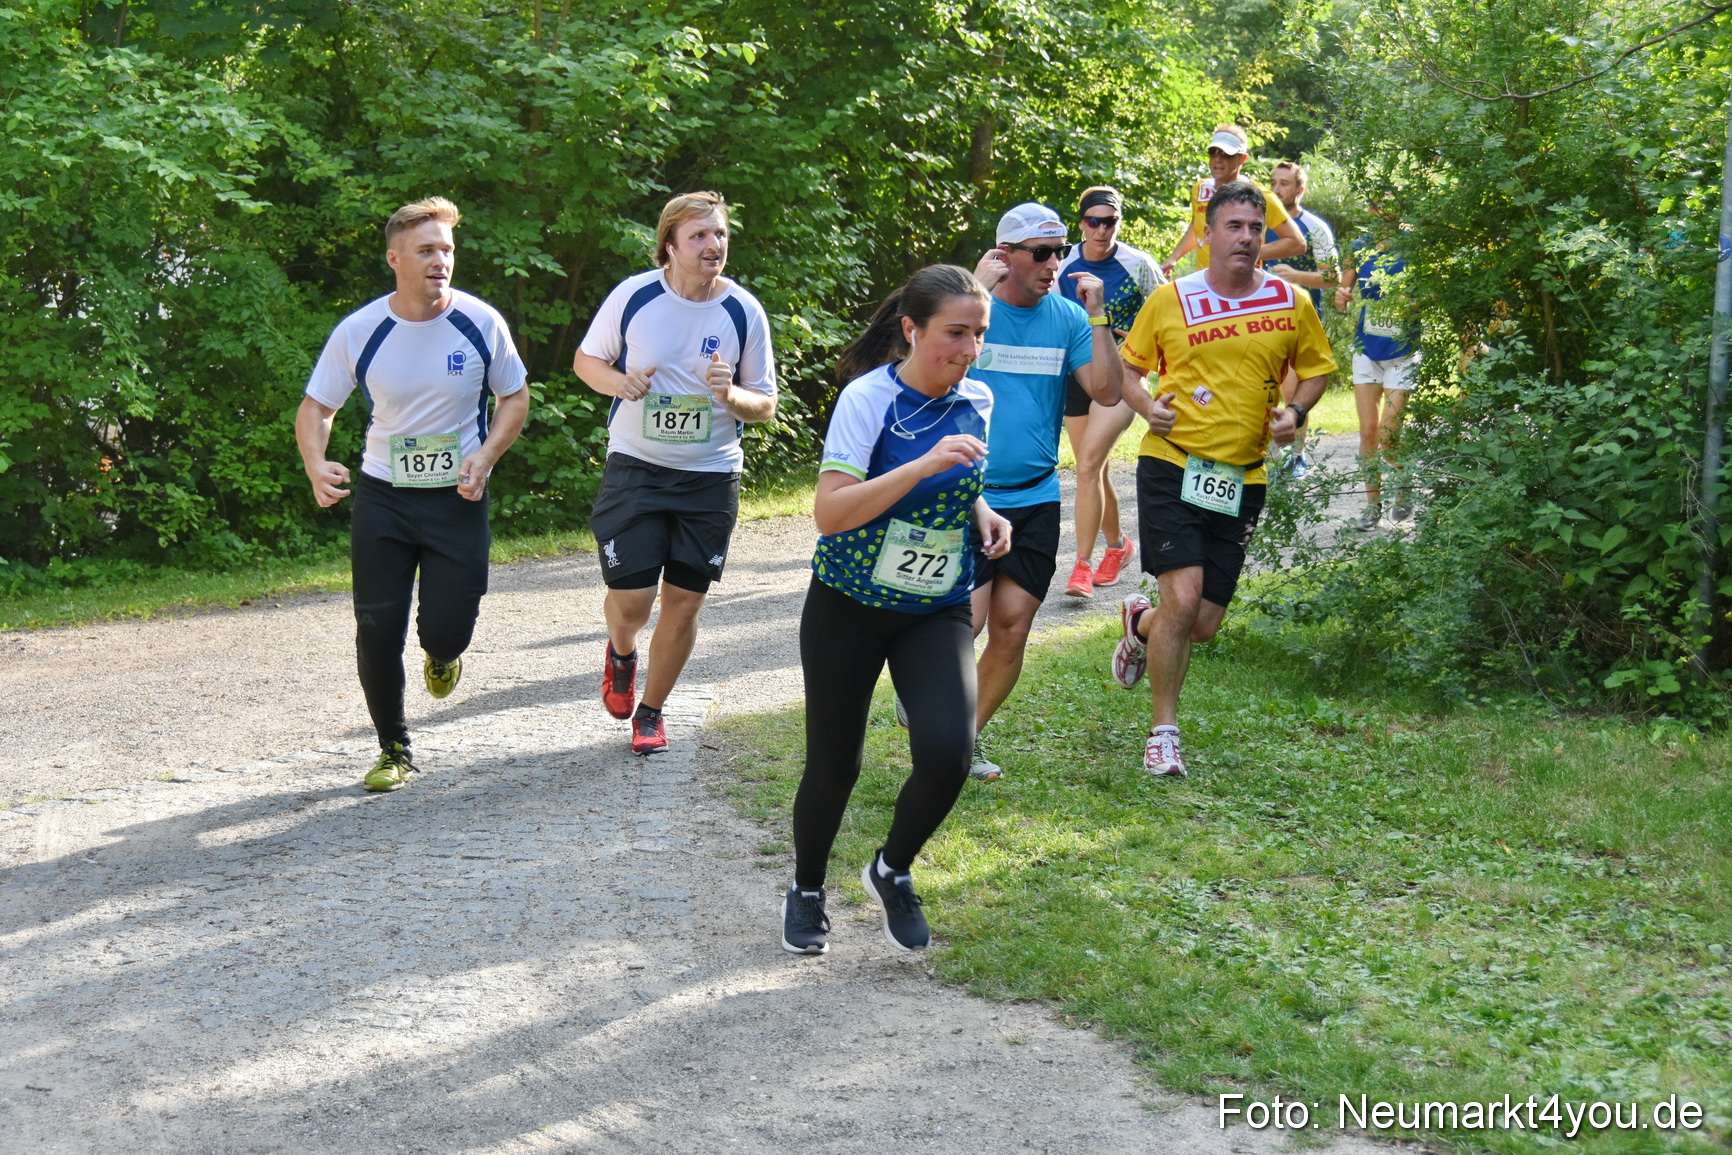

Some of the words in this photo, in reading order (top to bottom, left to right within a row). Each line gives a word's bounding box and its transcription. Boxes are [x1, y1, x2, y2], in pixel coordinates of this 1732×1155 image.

[1188, 324, 1240, 347] MAX
[1246, 316, 1296, 334] BÖGL
[652, 410, 701, 430] 1871
[400, 451, 454, 473] 1873
[1192, 473, 1237, 501] 1656
[897, 549, 949, 578] 272
[896, 572, 915, 582] Sitter
[916, 577, 943, 586] Angelika
